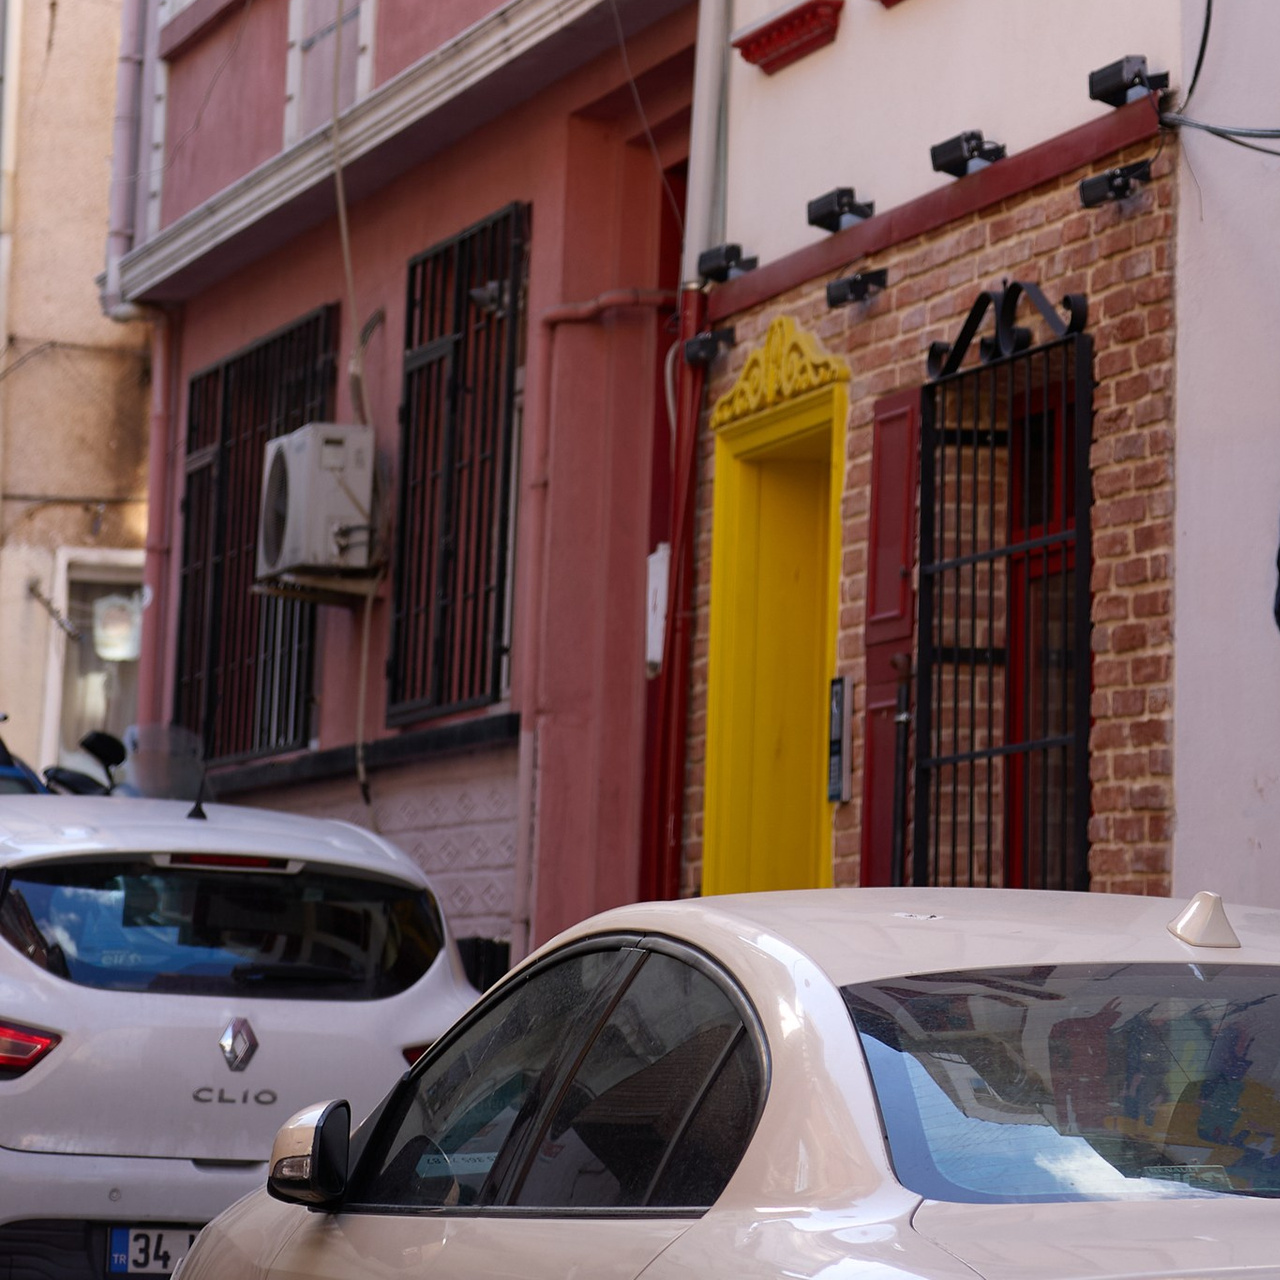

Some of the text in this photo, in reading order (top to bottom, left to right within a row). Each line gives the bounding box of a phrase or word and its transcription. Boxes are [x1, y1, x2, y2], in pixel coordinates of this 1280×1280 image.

[192, 1087, 278, 1105] CLIO
[112, 1254, 127, 1265] TR
[132, 1233, 171, 1270] 34
